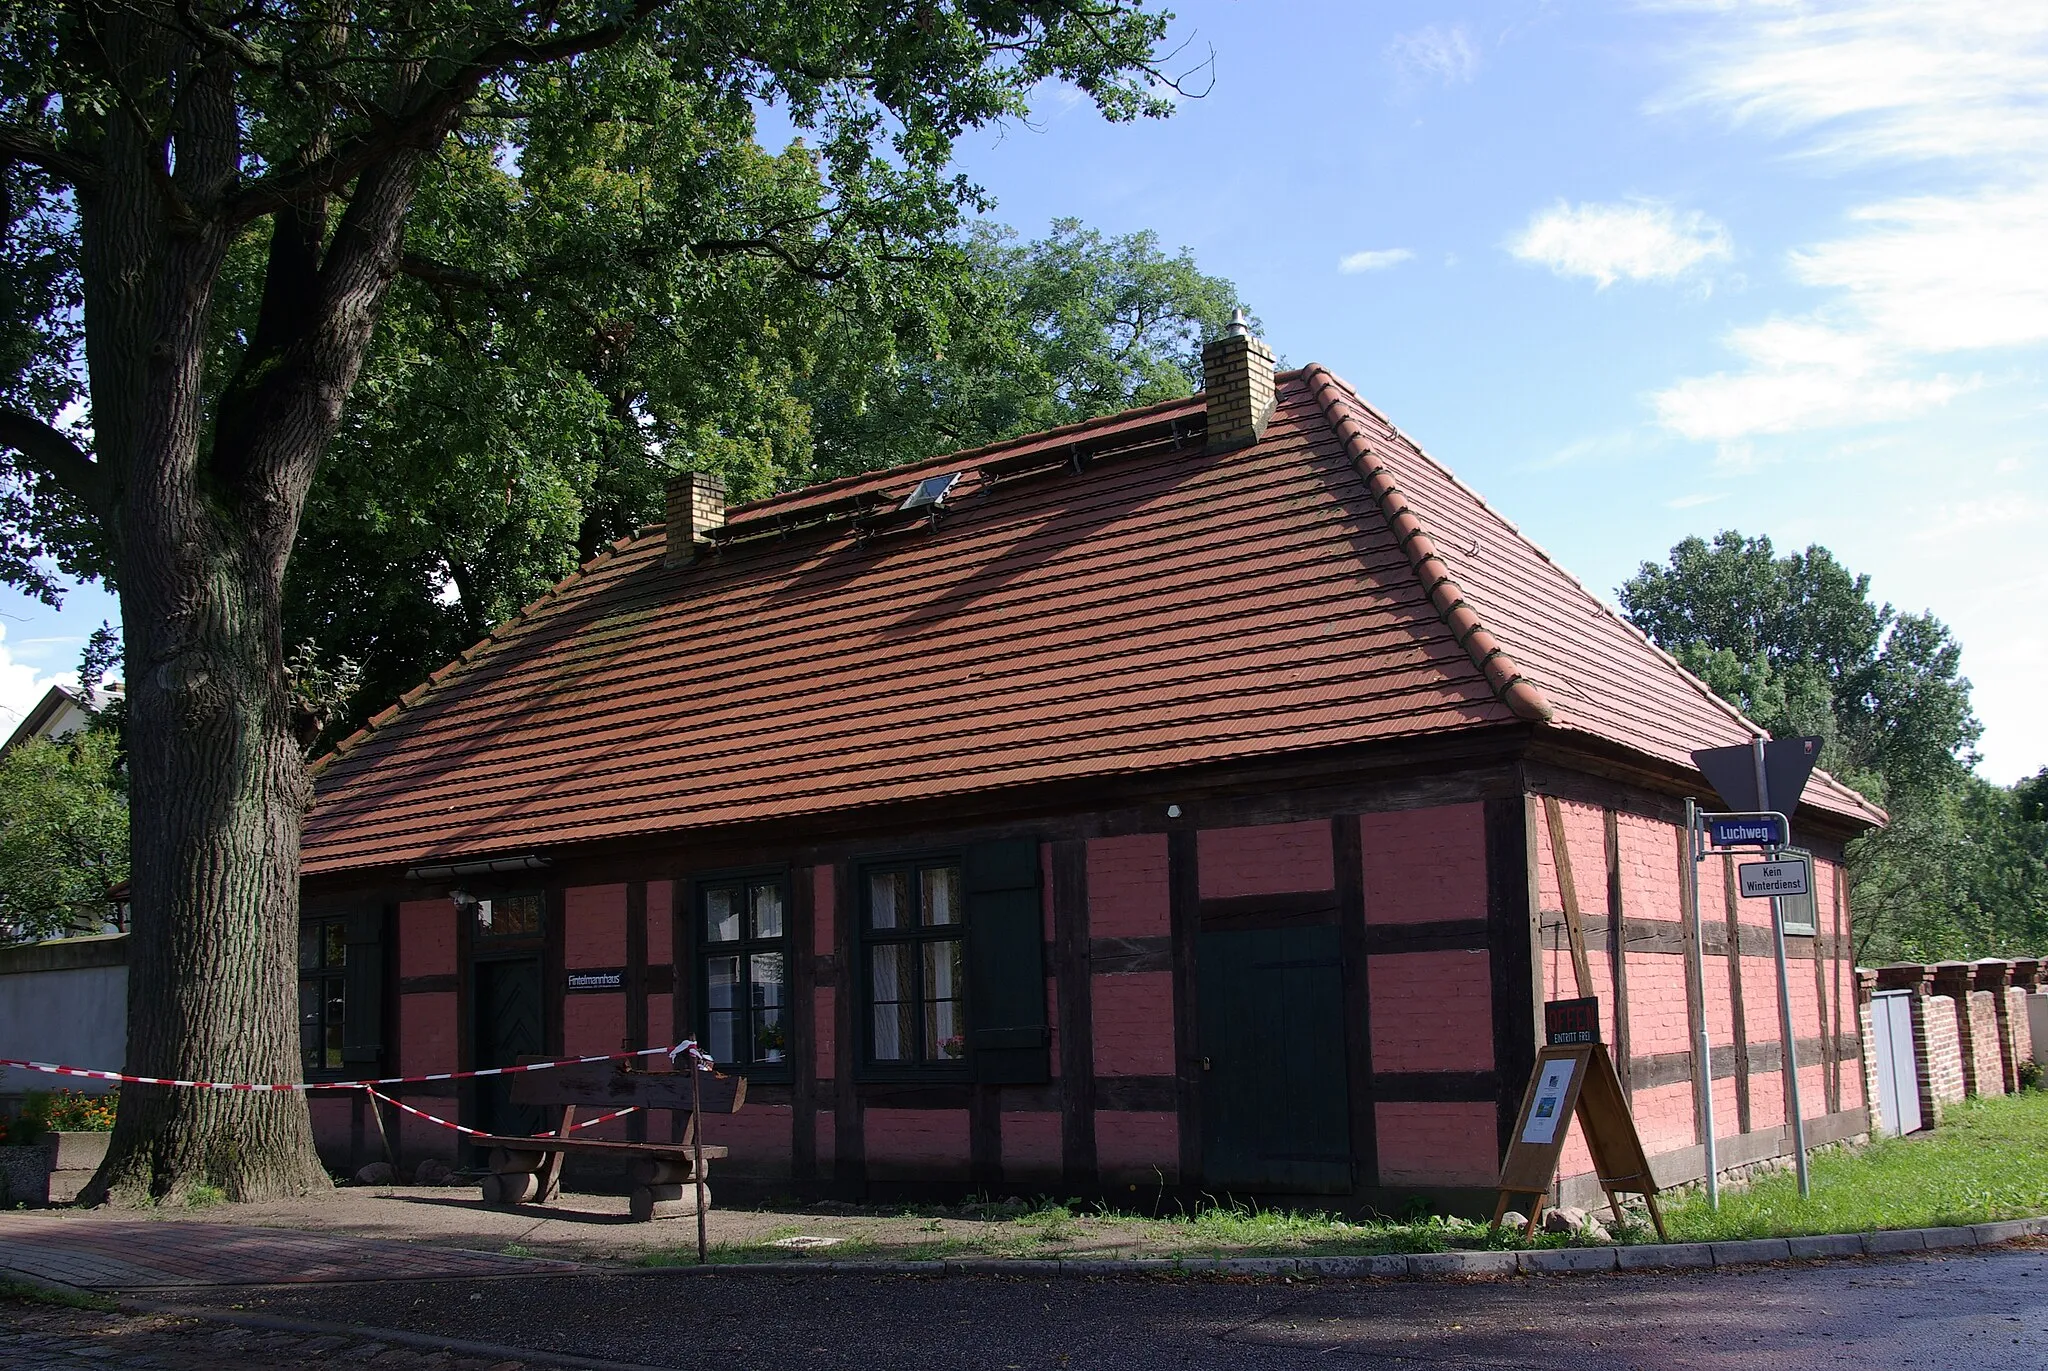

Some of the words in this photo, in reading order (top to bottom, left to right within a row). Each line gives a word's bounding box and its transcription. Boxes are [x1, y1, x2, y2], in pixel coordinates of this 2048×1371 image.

[1720, 826, 1768, 842] Luchweg
[1763, 867, 1782, 877] Kein
[1746, 879, 1801, 891] Winterdienst
[568, 974, 620, 986] Fintelmannhaus
[1549, 1005, 1595, 1032] OFFEN
[1578, 1031, 1591, 1041] FREI
